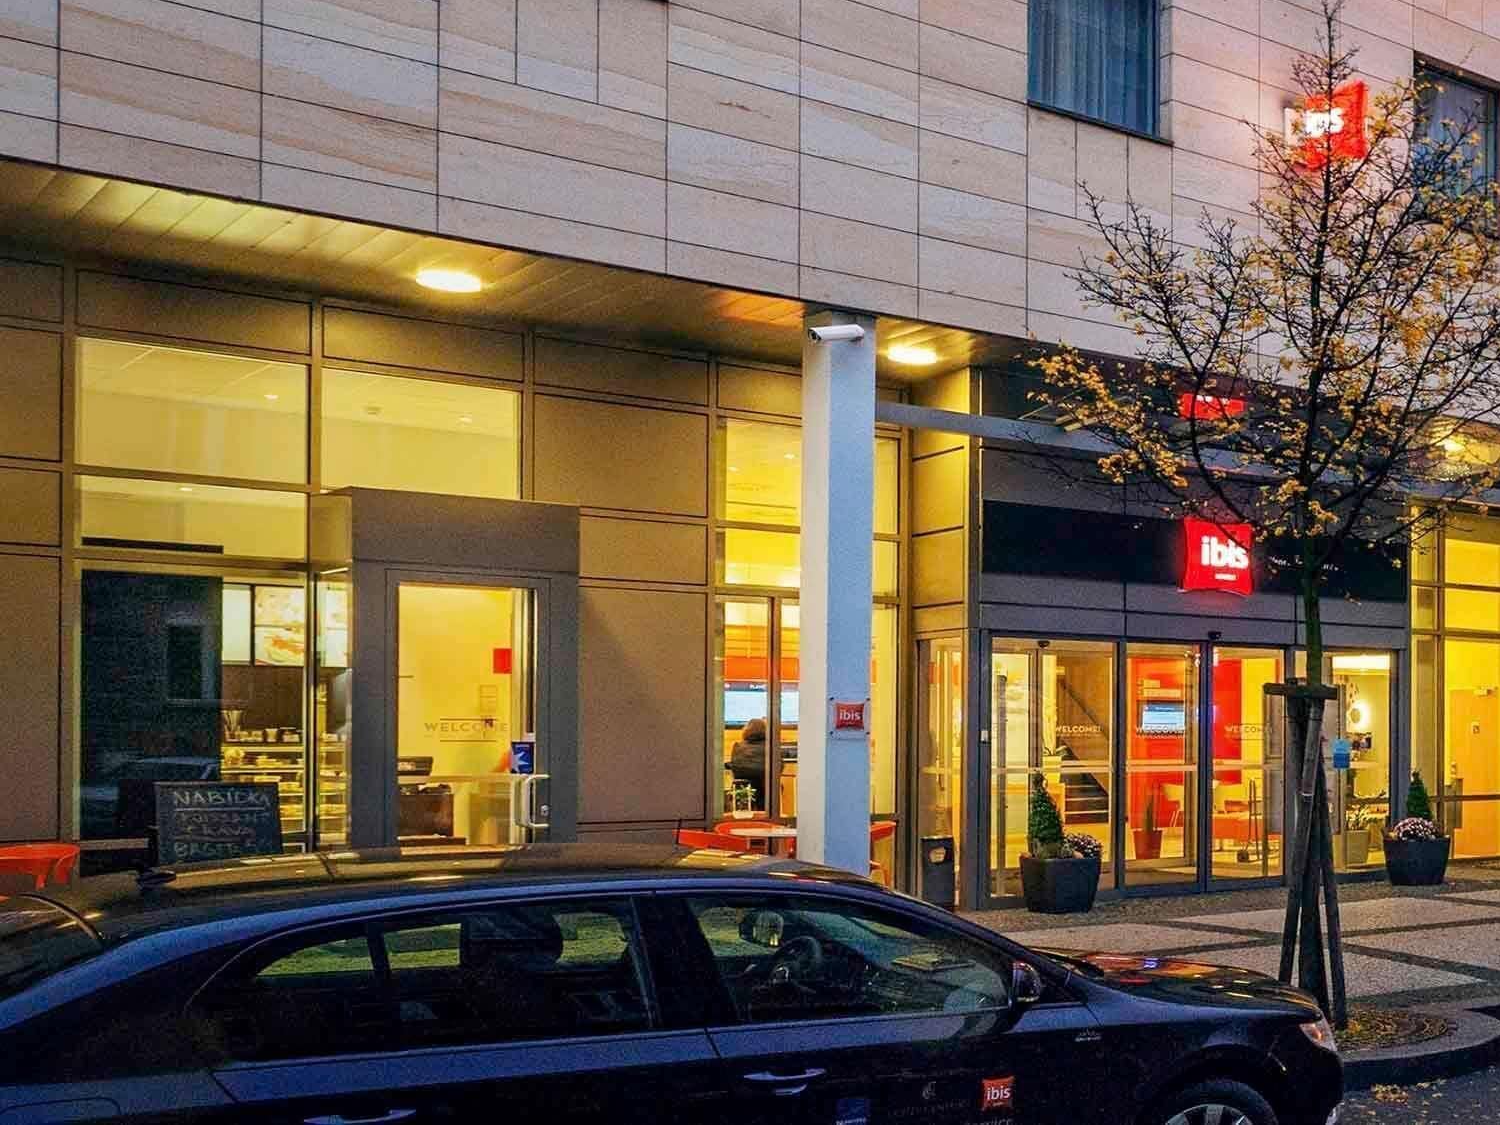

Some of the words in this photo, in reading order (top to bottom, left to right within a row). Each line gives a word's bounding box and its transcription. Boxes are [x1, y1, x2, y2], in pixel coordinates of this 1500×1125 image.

[1200, 534, 1249, 570] ibis
[838, 709, 861, 721] ibis
[986, 1086, 1011, 1101] ibis
